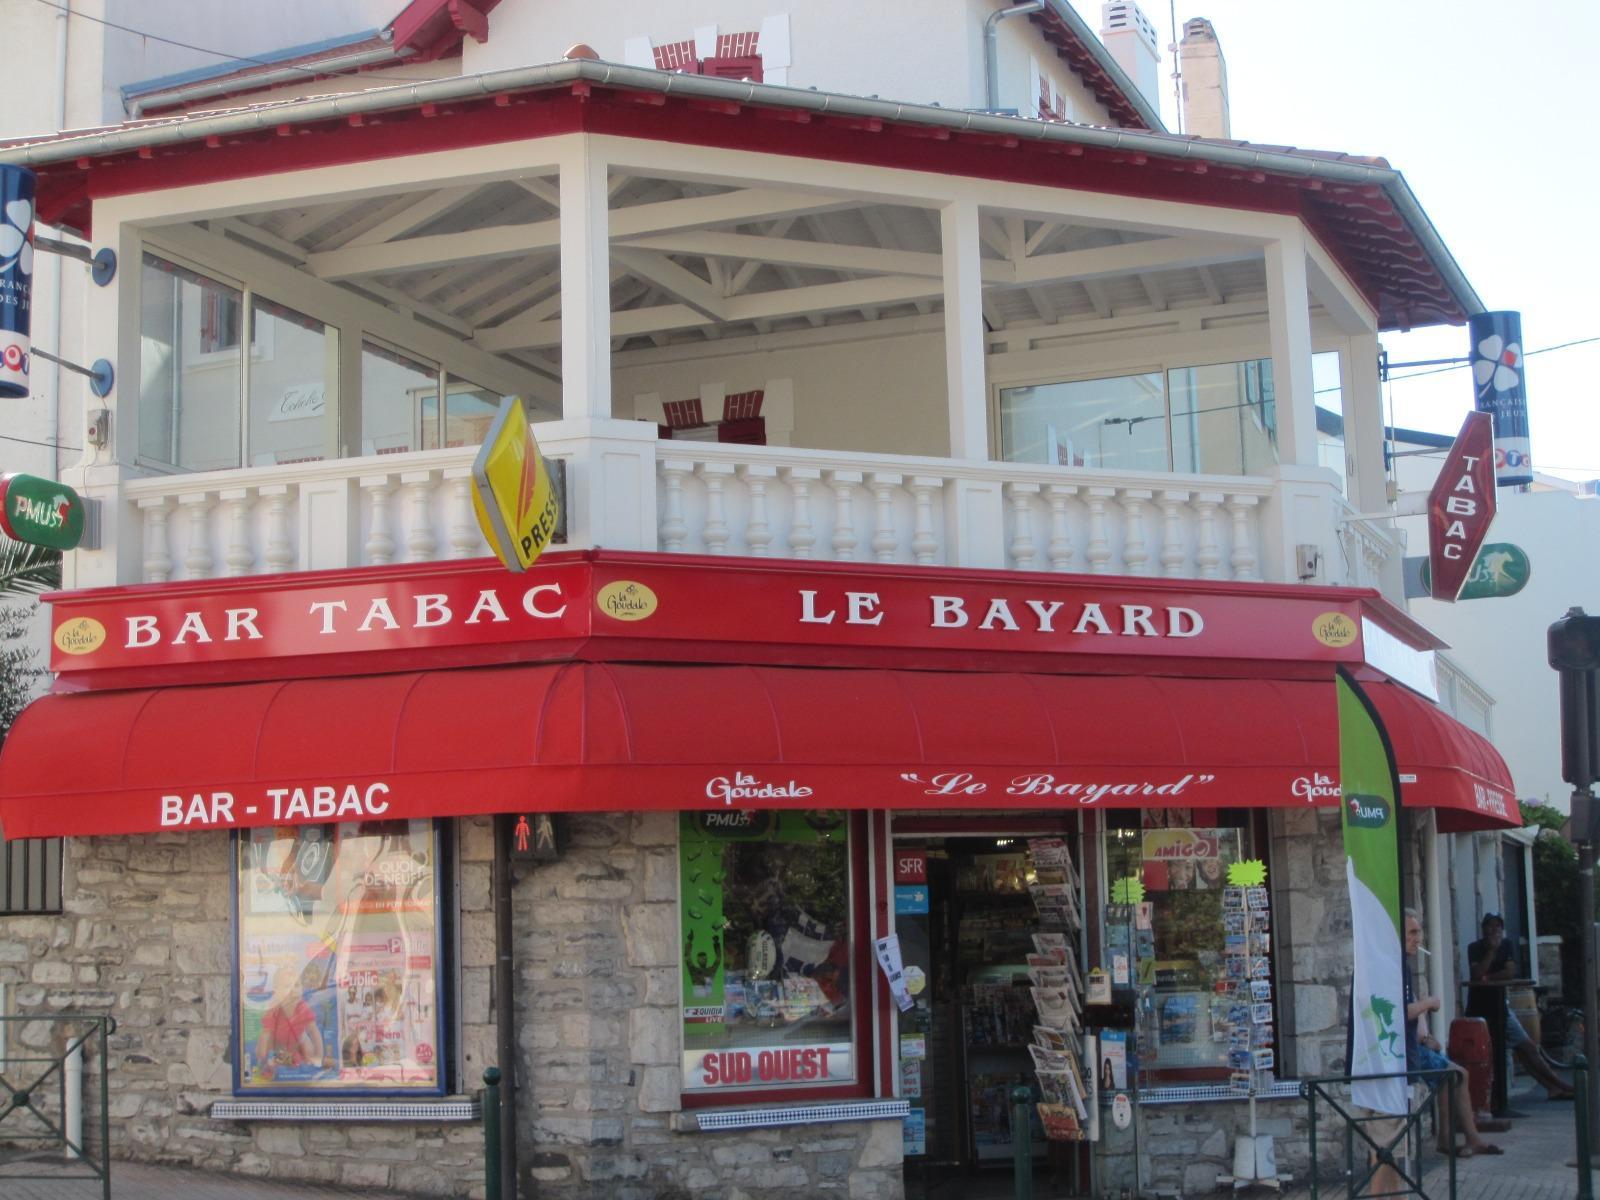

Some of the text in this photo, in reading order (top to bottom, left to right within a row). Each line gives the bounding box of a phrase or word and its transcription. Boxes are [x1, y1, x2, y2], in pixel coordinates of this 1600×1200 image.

[520, 484, 558, 560] PRESS
[1443, 455, 1480, 560] TABAC
[124, 582, 568, 649] BAR TABAC
[798, 590, 1204, 637] LE BAYARD
[706, 776, 814, 805] Goudale
[736, 771, 761, 786] la
[1291, 776, 1342, 802] Goud
[1313, 771, 1335, 786] la
[160, 791, 235, 826] BAR
[266, 782, 390, 820] TABAC
[900, 858, 923, 873] SFR
[703, 1048, 831, 1085] SUD OUEST
